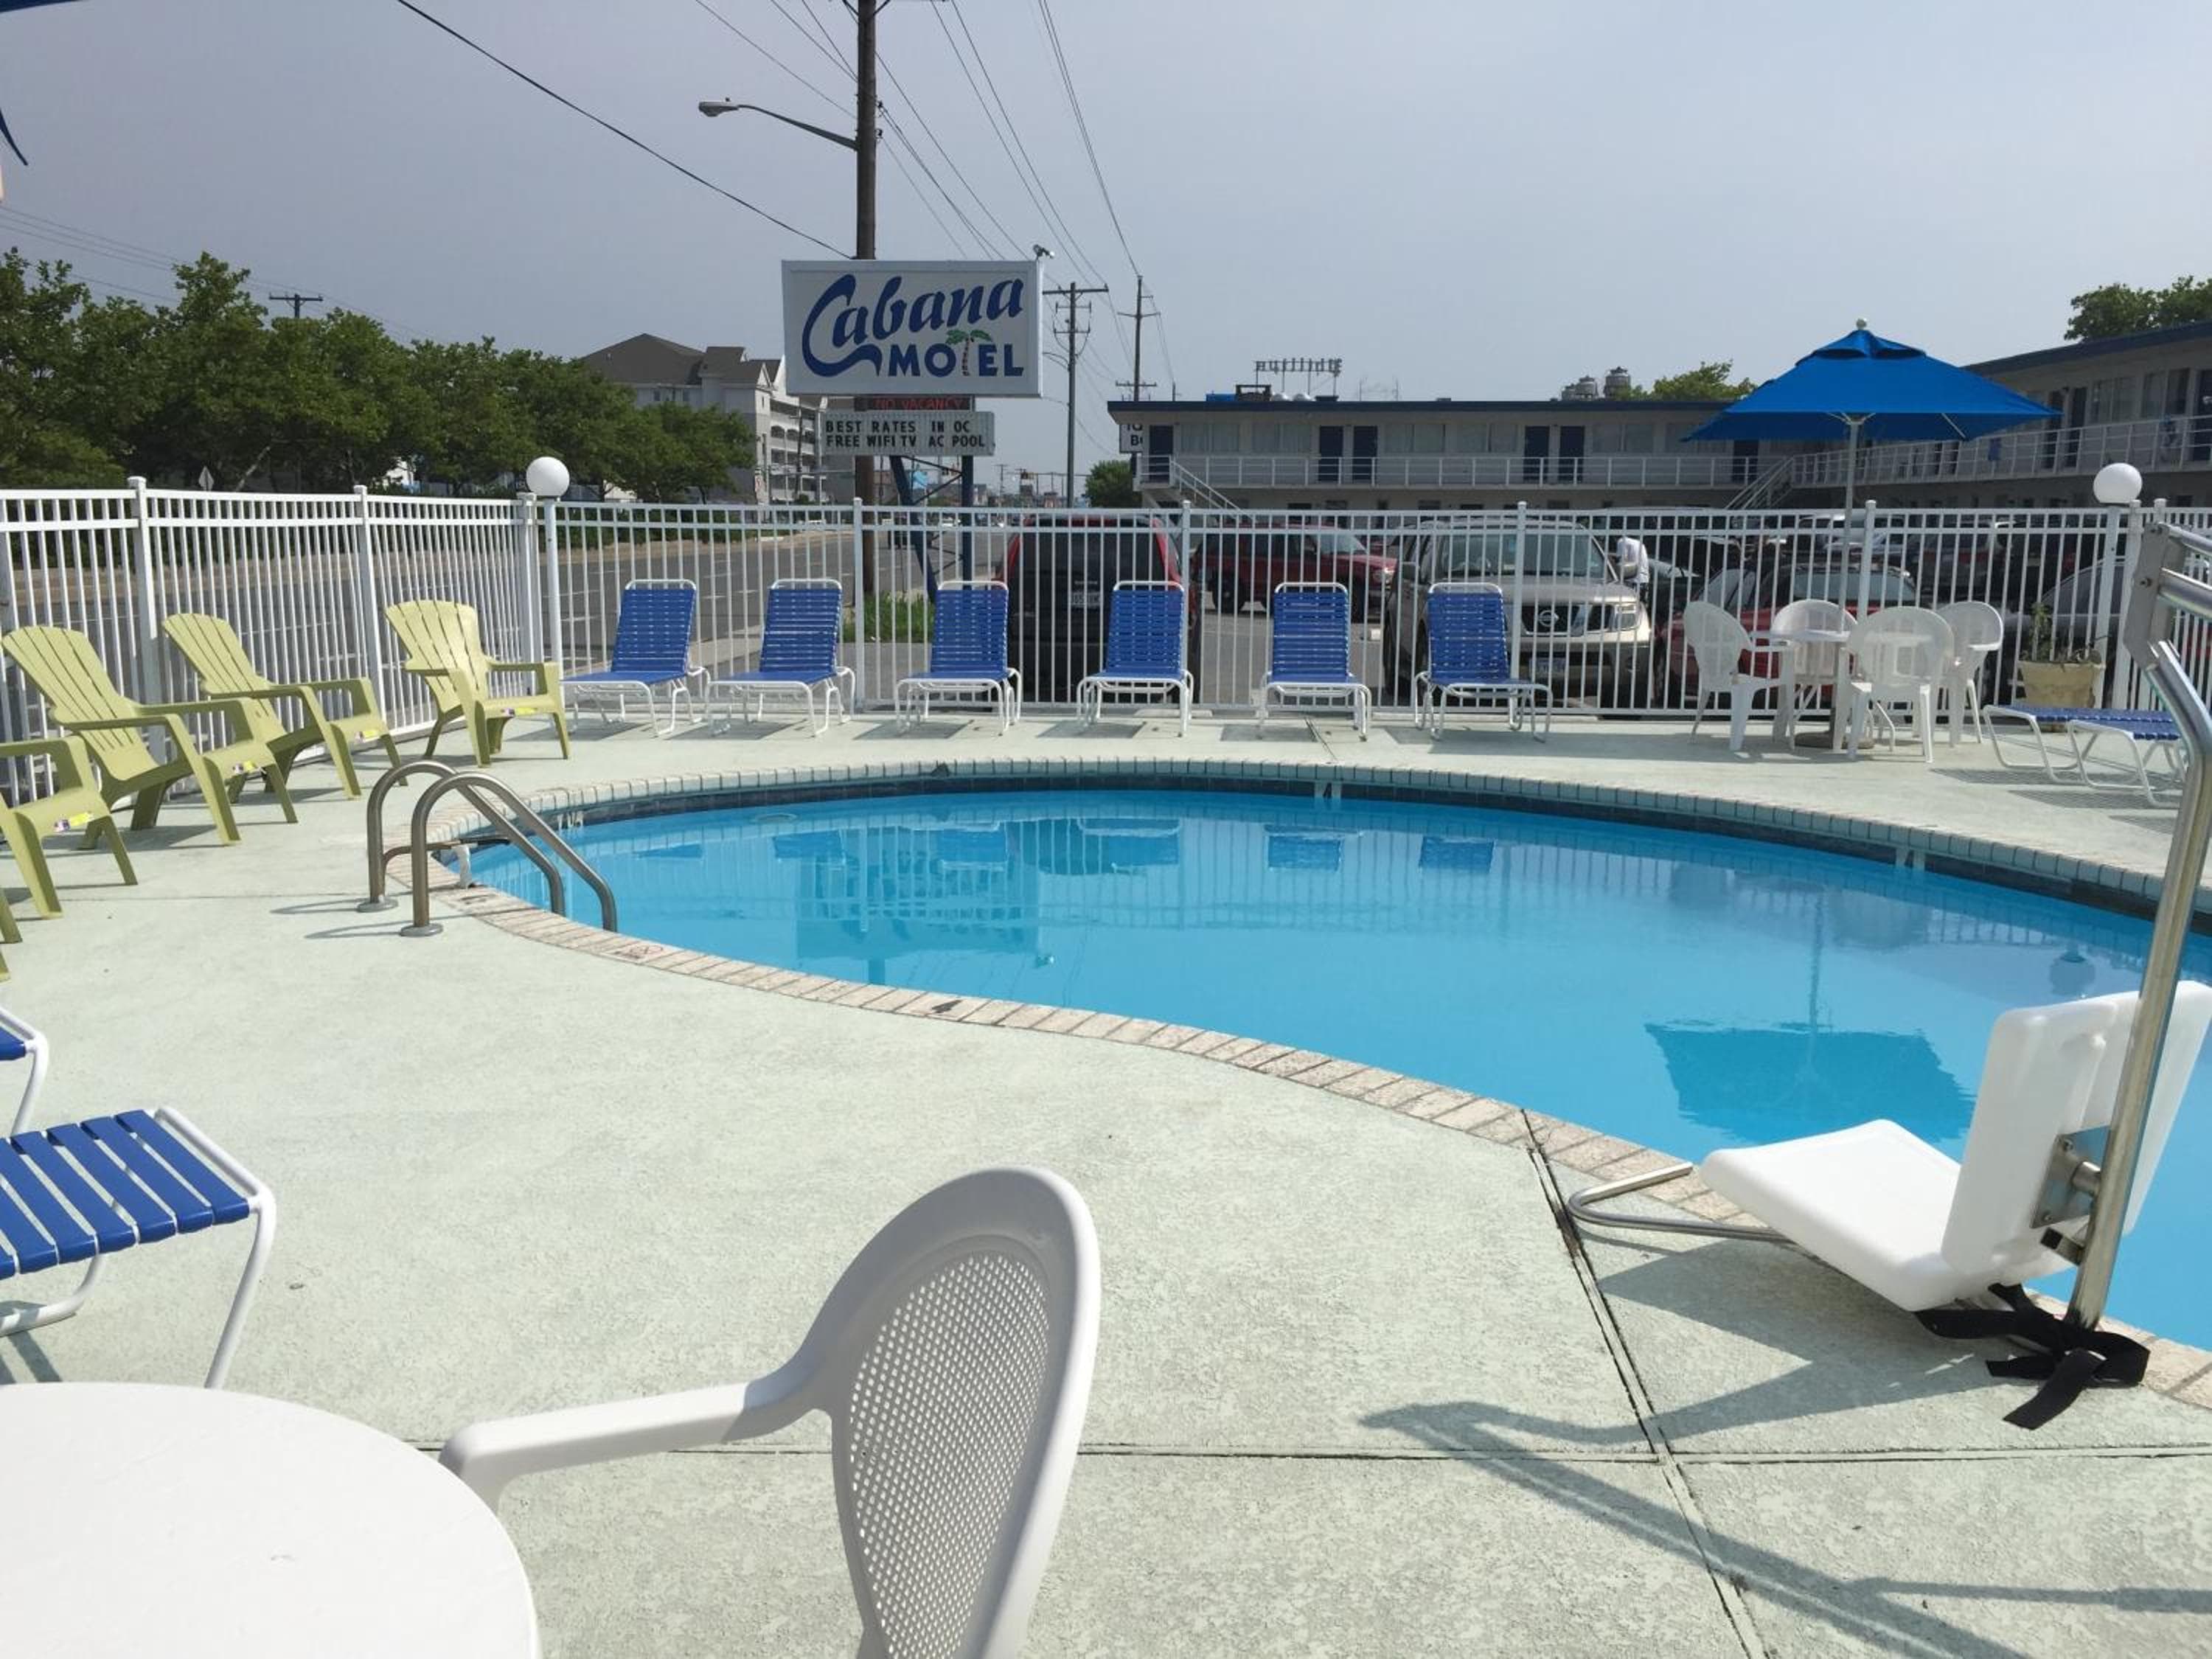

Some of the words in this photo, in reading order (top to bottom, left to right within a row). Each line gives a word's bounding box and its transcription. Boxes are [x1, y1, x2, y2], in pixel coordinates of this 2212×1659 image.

[801, 274, 1024, 377] Cabana
[826, 421, 861, 433] BEST
[872, 420, 916, 434] RATES
[931, 421, 945, 433] IN
[954, 420, 970, 433] OC
[826, 435, 860, 448] FREE
[866, 435, 896, 447] WIFI
[901, 435, 917, 447] TV
[928, 435, 945, 447] AC
[952, 435, 985, 448] POOL
